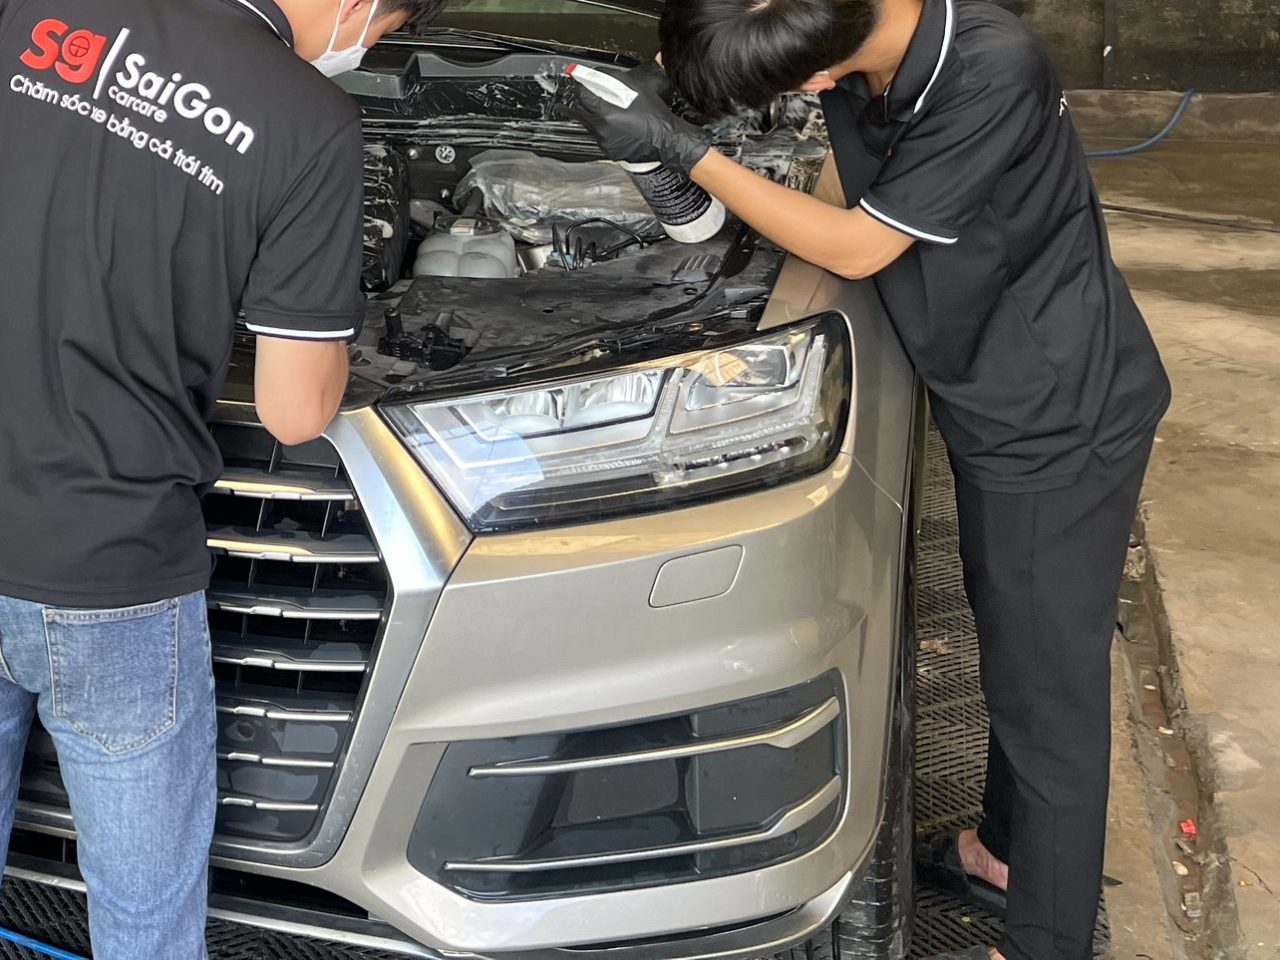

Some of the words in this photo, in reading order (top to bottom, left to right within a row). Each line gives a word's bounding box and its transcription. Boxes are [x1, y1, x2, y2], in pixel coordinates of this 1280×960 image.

[10, 74, 59, 104] Chăm
[60, 93, 91, 116] sóc
[91, 105, 107, 123] xe
[106, 114, 149, 149] bằng
[149, 140, 173, 159] cả
[173, 149, 200, 176] trái
[200, 166, 225, 195] tim
[108, 85, 168, 123] carcare
[115, 53, 255, 154] SaiGon
